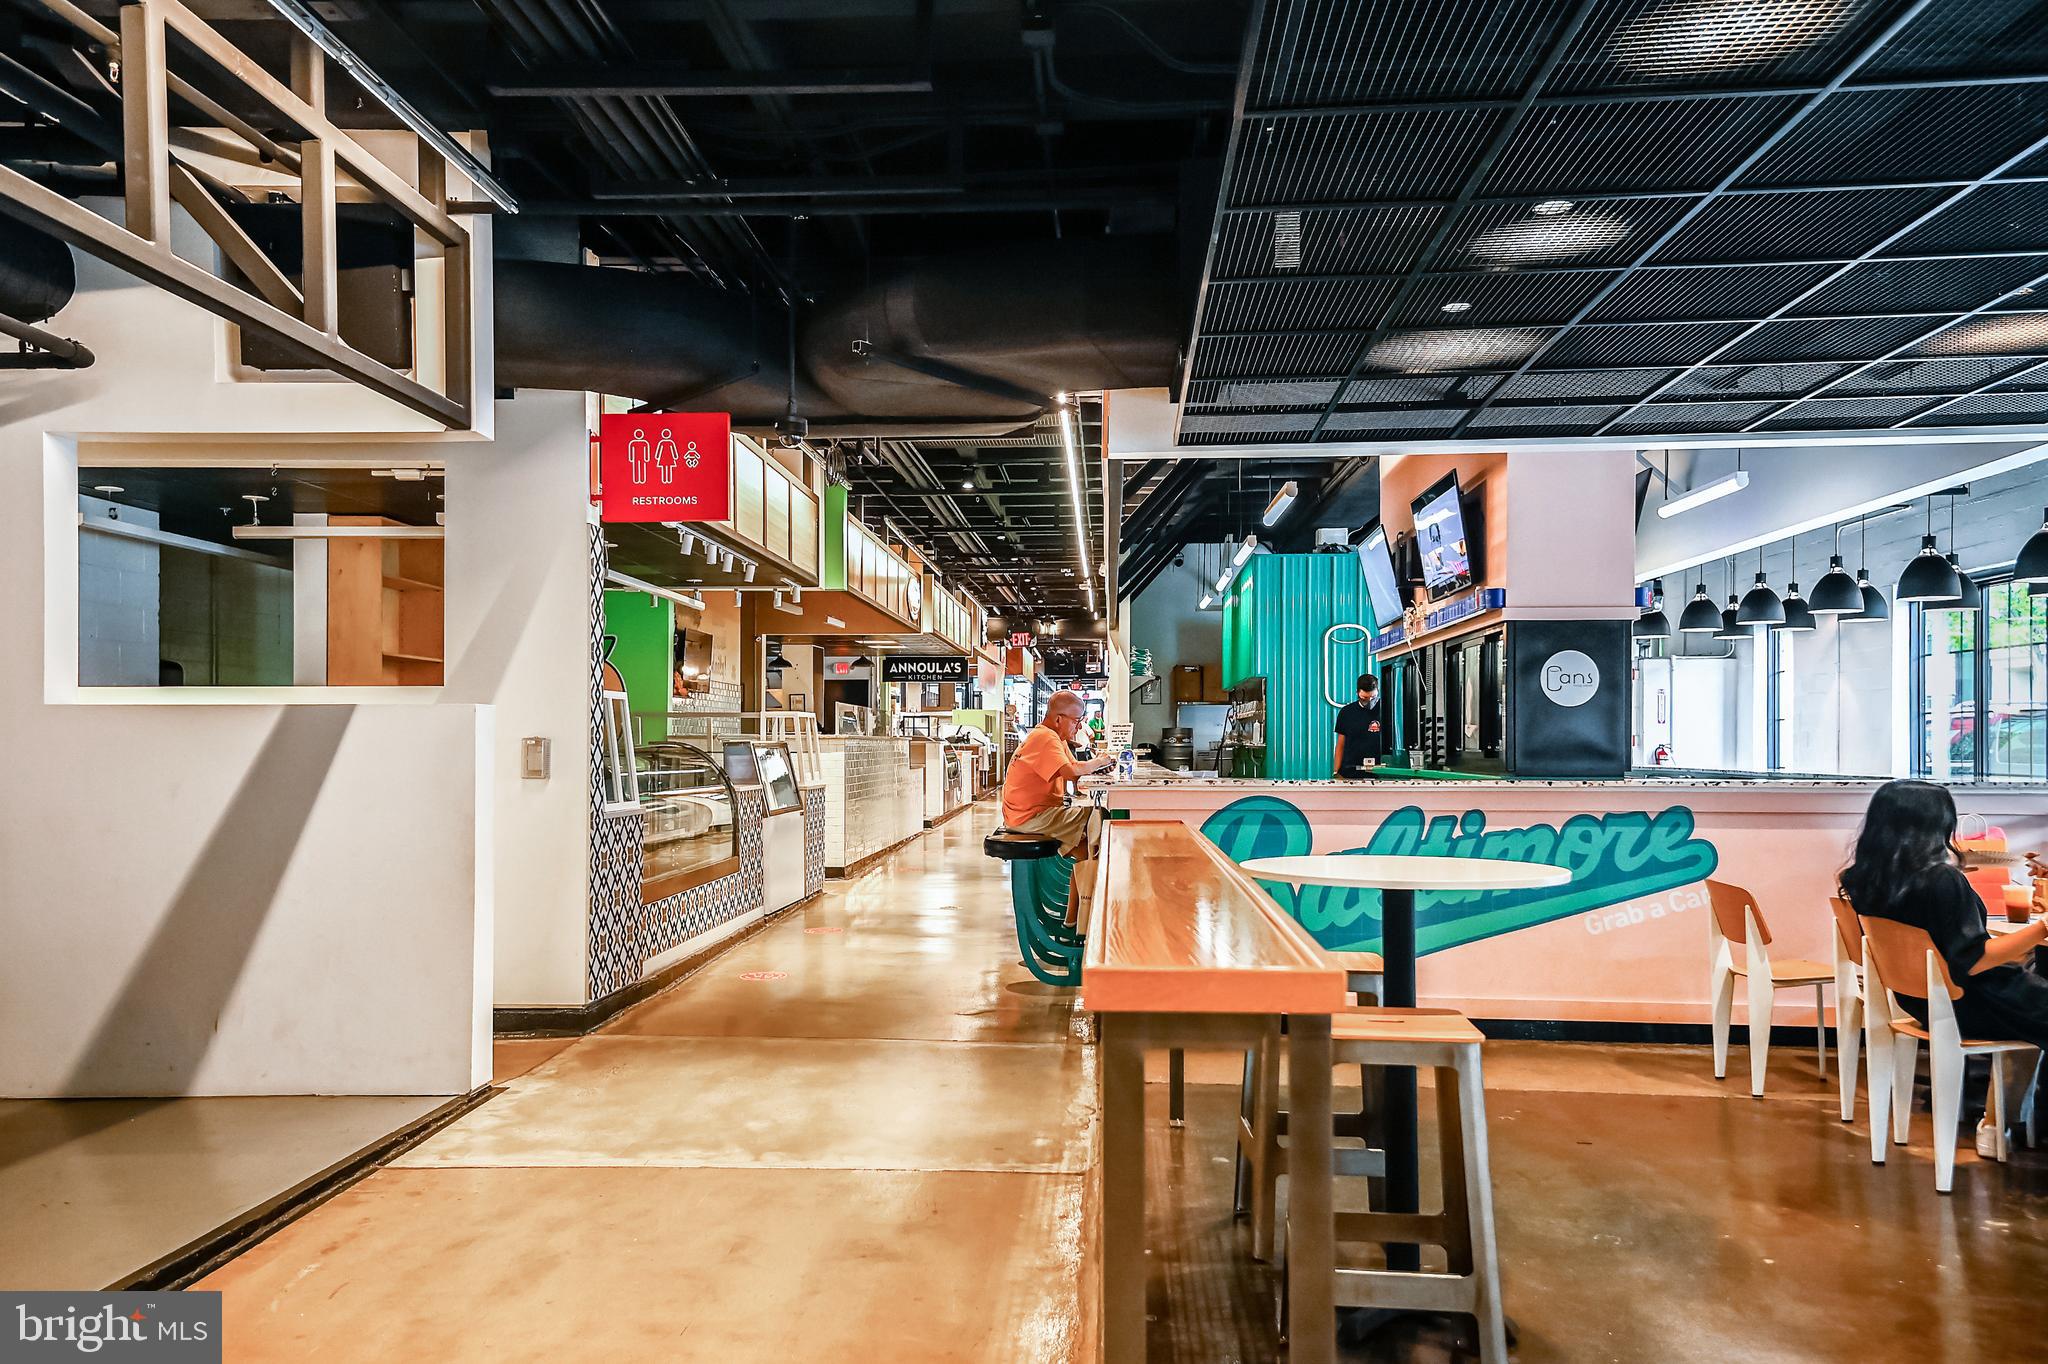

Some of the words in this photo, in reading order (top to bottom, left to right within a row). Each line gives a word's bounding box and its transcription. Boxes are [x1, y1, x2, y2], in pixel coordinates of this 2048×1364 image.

[632, 495, 698, 505] RESTROOMS
[1011, 632, 1030, 646] EXIT
[889, 662, 962, 673] ANNOULA'S
[1547, 665, 1593, 691] Cans
[1584, 903, 1645, 936] Grab
[1649, 901, 1665, 919] a
